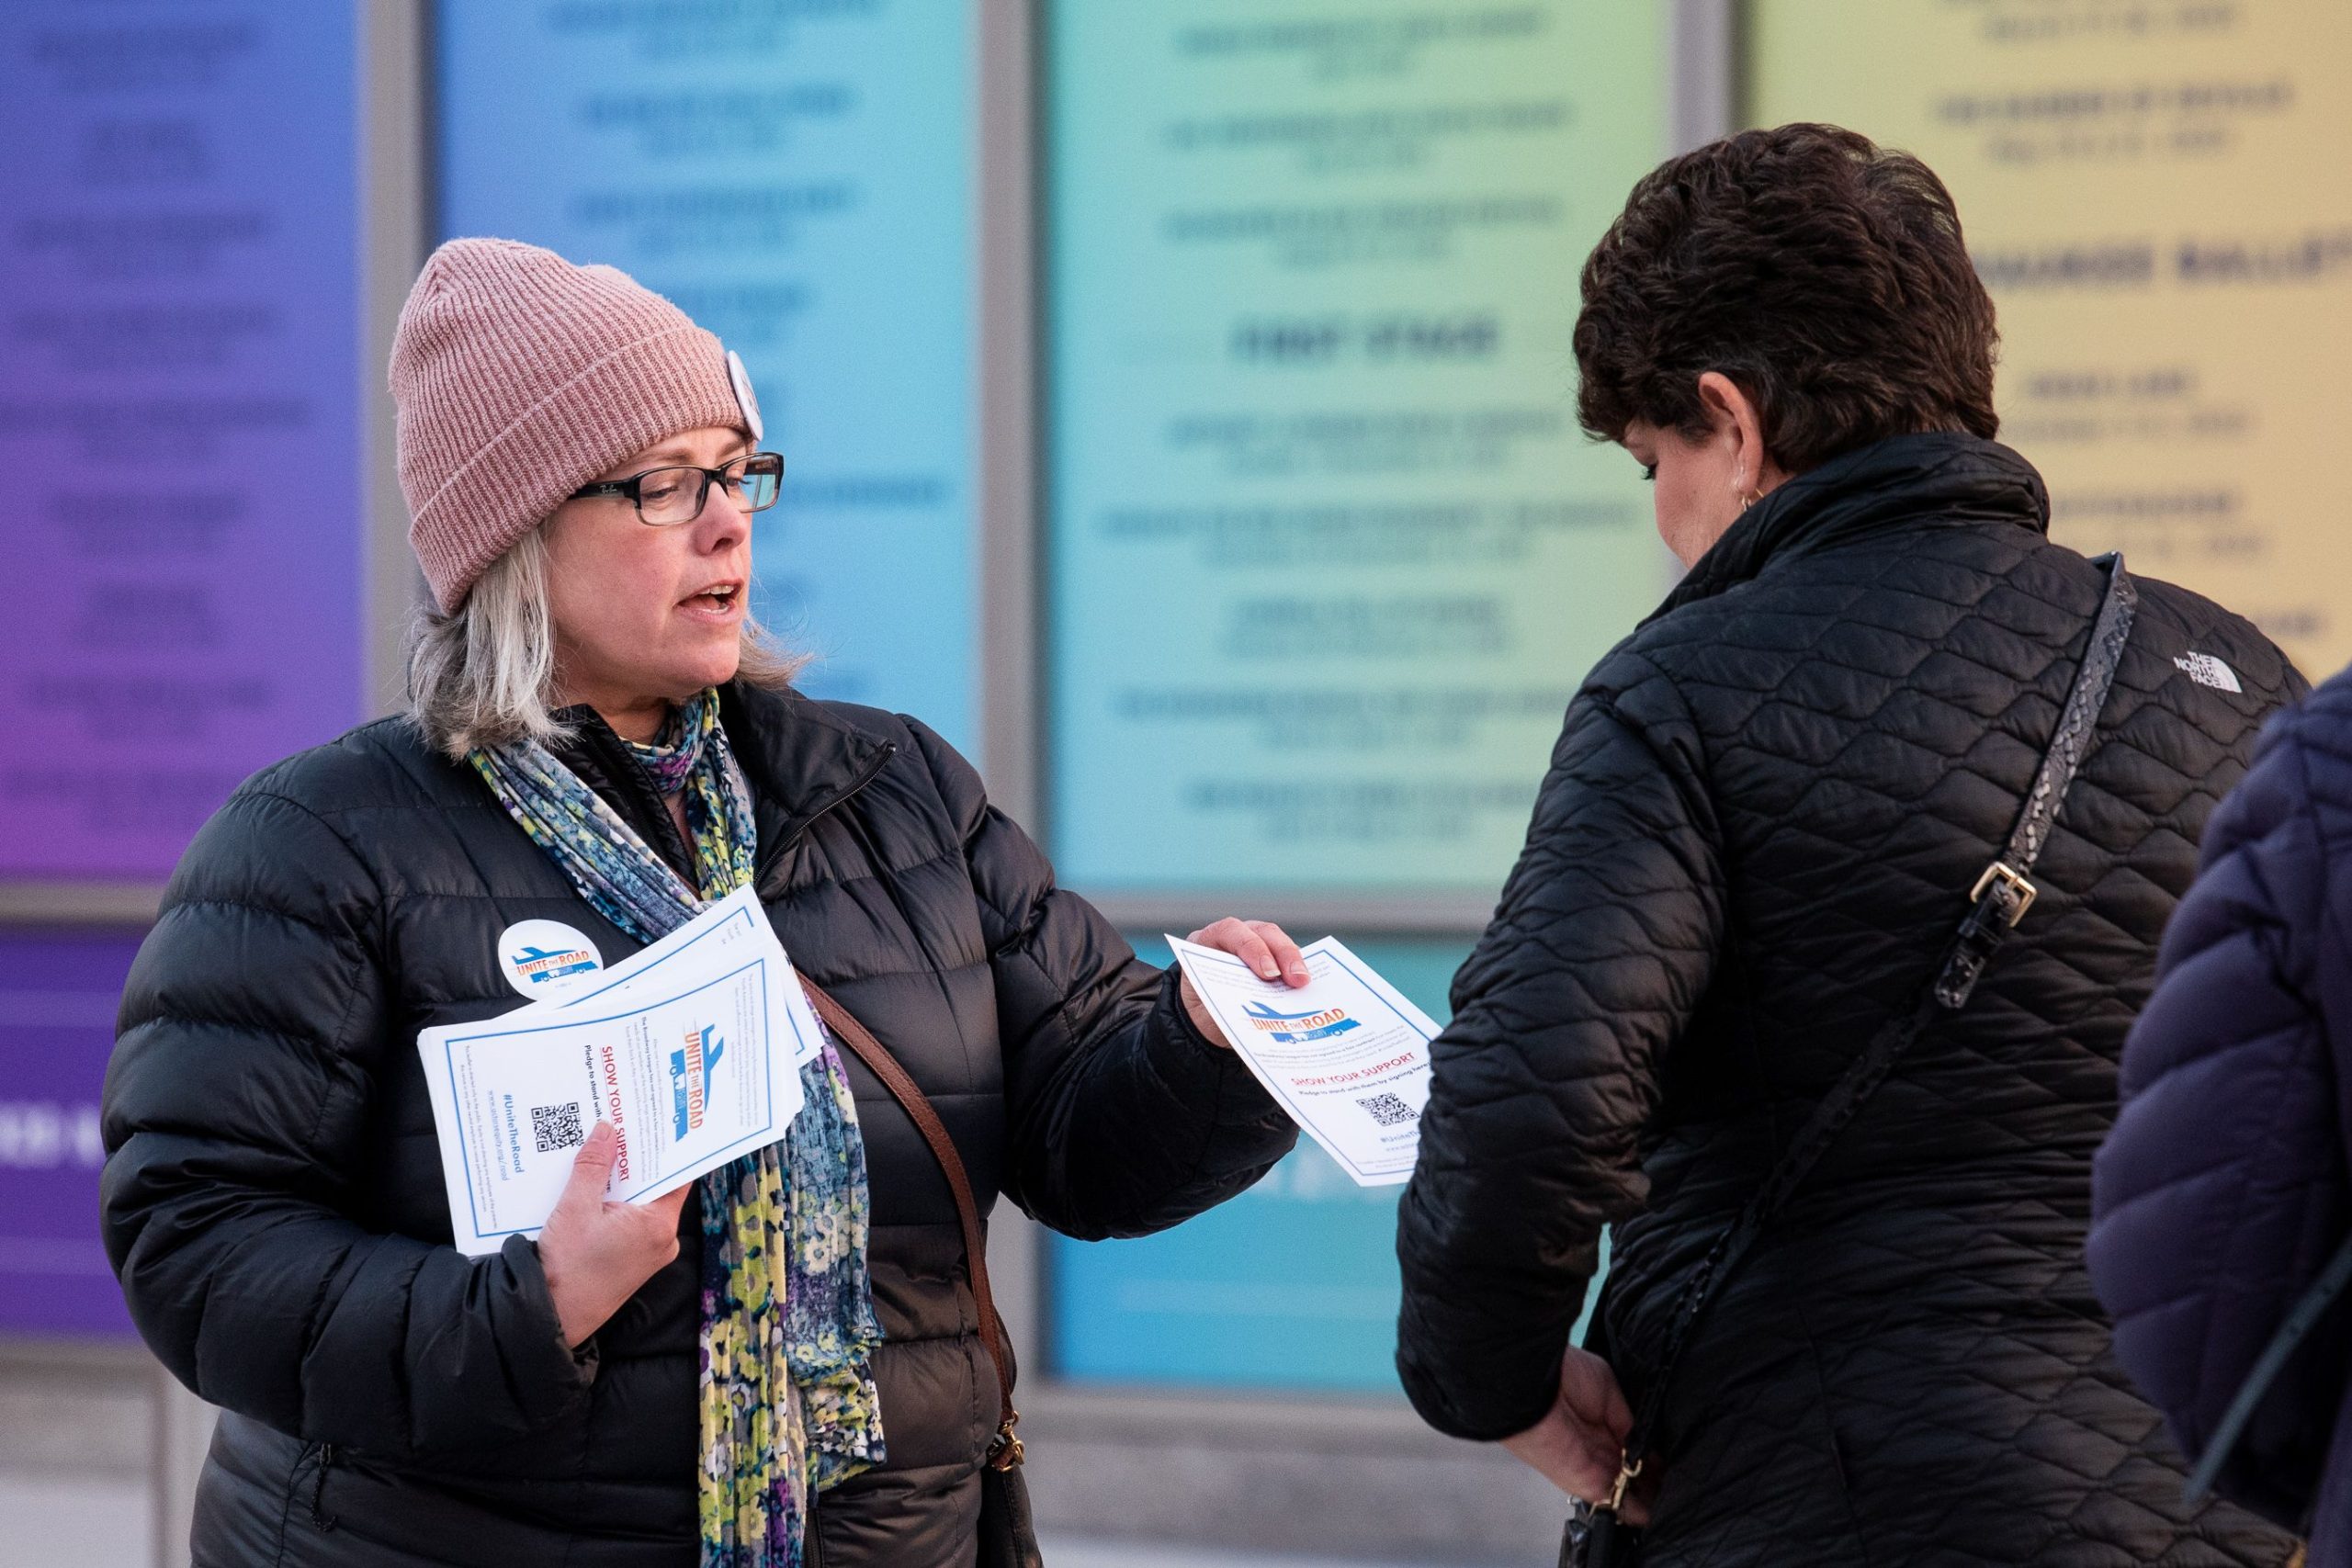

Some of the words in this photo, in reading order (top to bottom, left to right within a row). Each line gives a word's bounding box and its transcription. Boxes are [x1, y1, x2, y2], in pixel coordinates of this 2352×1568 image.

[2173, 657, 2213, 676] NORTH
[2187, 650, 2211, 664] THE
[2190, 672, 2222, 687] FACE
[517, 960, 548, 975] UNITE
[559, 951, 589, 964] ROAD
[1251, 1018, 1291, 1031] UNITE
[1302, 1009, 1344, 1028] ROAD
[583, 1044, 594, 1069] Pledge
[684, 1031, 702, 1074] UNITE
[588, 1070, 594, 1078] to
[601, 1045, 618, 1086] SHOW
[1327, 1071, 1363, 1081] YOUR
[1362, 1052, 1414, 1076] SUPPORT
[590, 1079, 599, 1100] stand
[594, 1100, 602, 1117] with
[608, 1089, 623, 1124] YOUR
[688, 1088, 704, 1129] ROAD
[503, 1093, 525, 1173] #UniteTheRoad
[615, 1127, 628, 1180] SUPPORT
